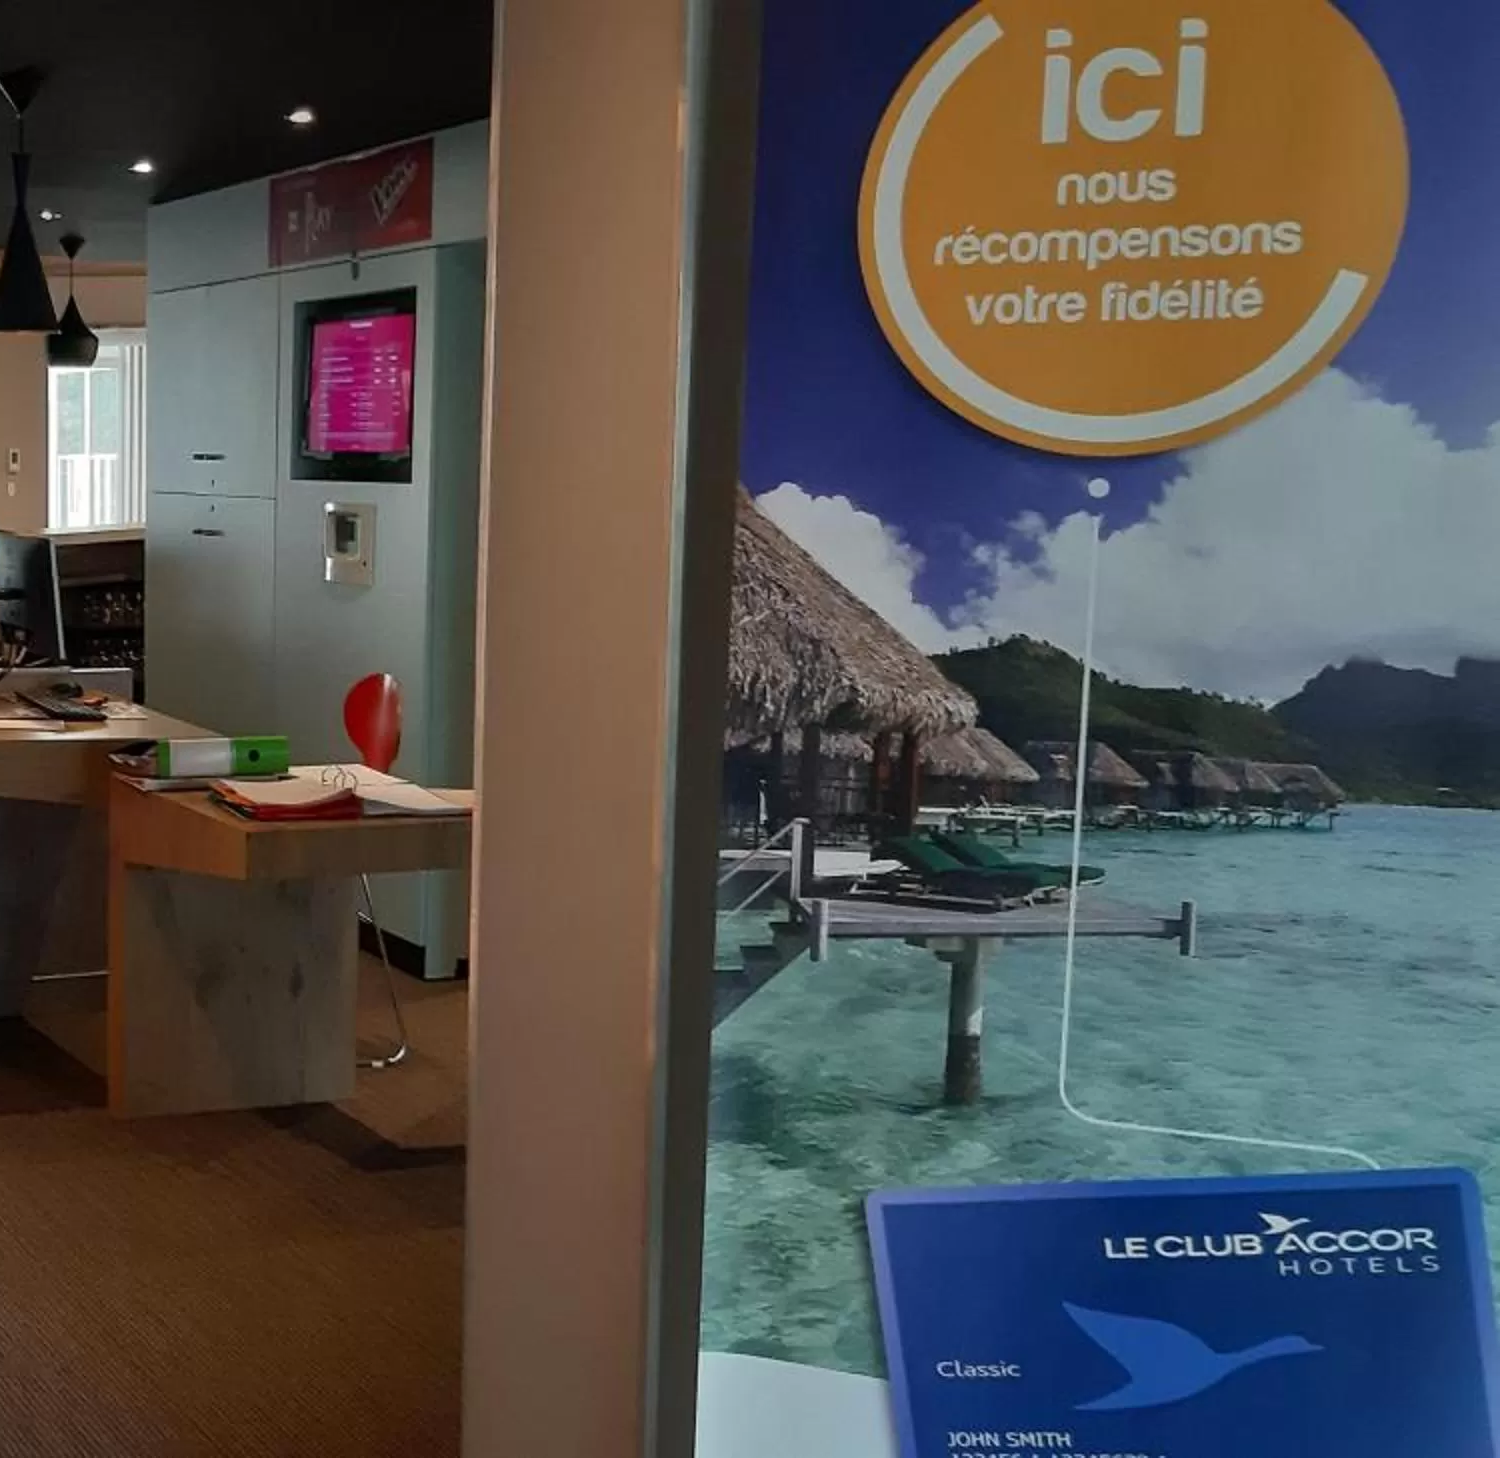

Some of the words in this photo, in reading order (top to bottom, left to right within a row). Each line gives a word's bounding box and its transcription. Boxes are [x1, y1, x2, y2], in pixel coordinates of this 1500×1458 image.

[1041, 18, 1208, 144] ici
[1057, 167, 1177, 205] nous
[934, 219, 1302, 270] récompensons
[965, 284, 1086, 325] votre
[1100, 278, 1264, 321] fidélité
[1104, 1236, 1149, 1259] LE
[1153, 1234, 1263, 1257] CLUB
[1275, 1227, 1437, 1255] ACCOR
[1278, 1255, 1441, 1277] HOTELS
[936, 1360, 1021, 1378] Classic
[948, 1431, 1000, 1448] JOHN
[1005, 1430, 1073, 1448] SMITH
